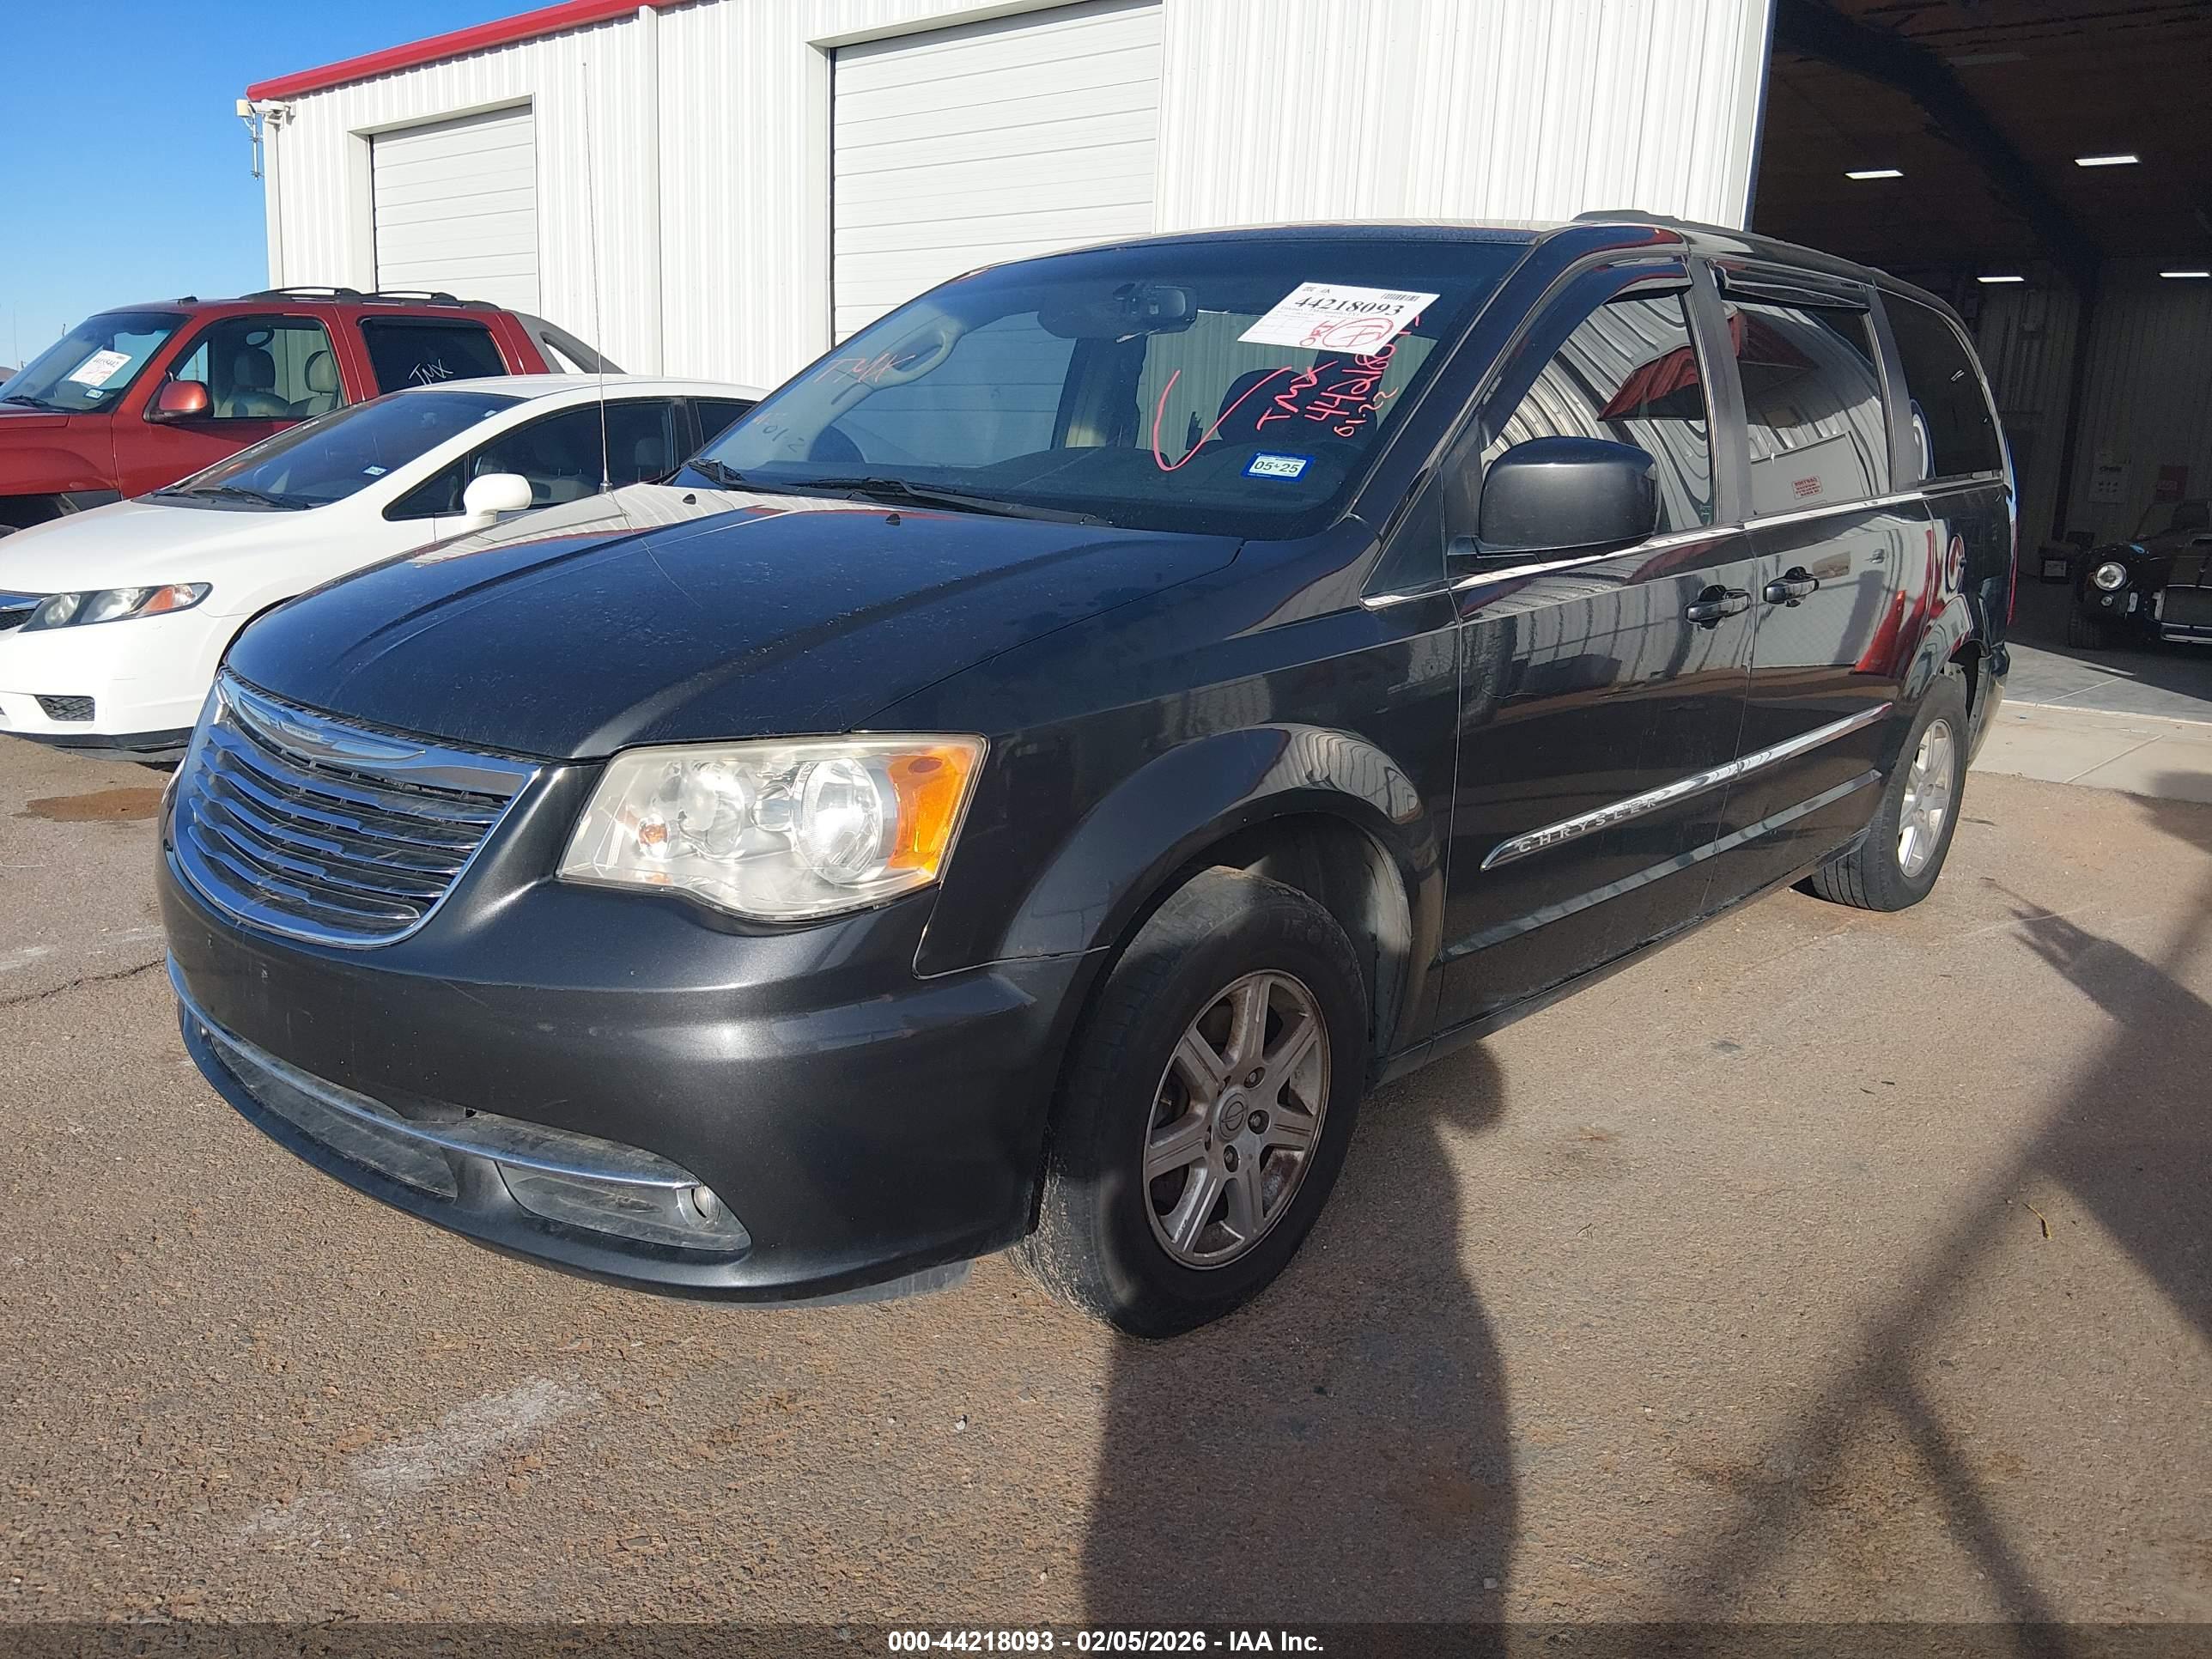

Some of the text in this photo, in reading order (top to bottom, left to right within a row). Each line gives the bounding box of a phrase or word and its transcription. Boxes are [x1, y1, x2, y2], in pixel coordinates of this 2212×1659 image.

[1295, 296, 1405, 316] 44218093
[408, 358, 454, 386] TMX
[1518, 797, 1656, 853] CHRYSLER
